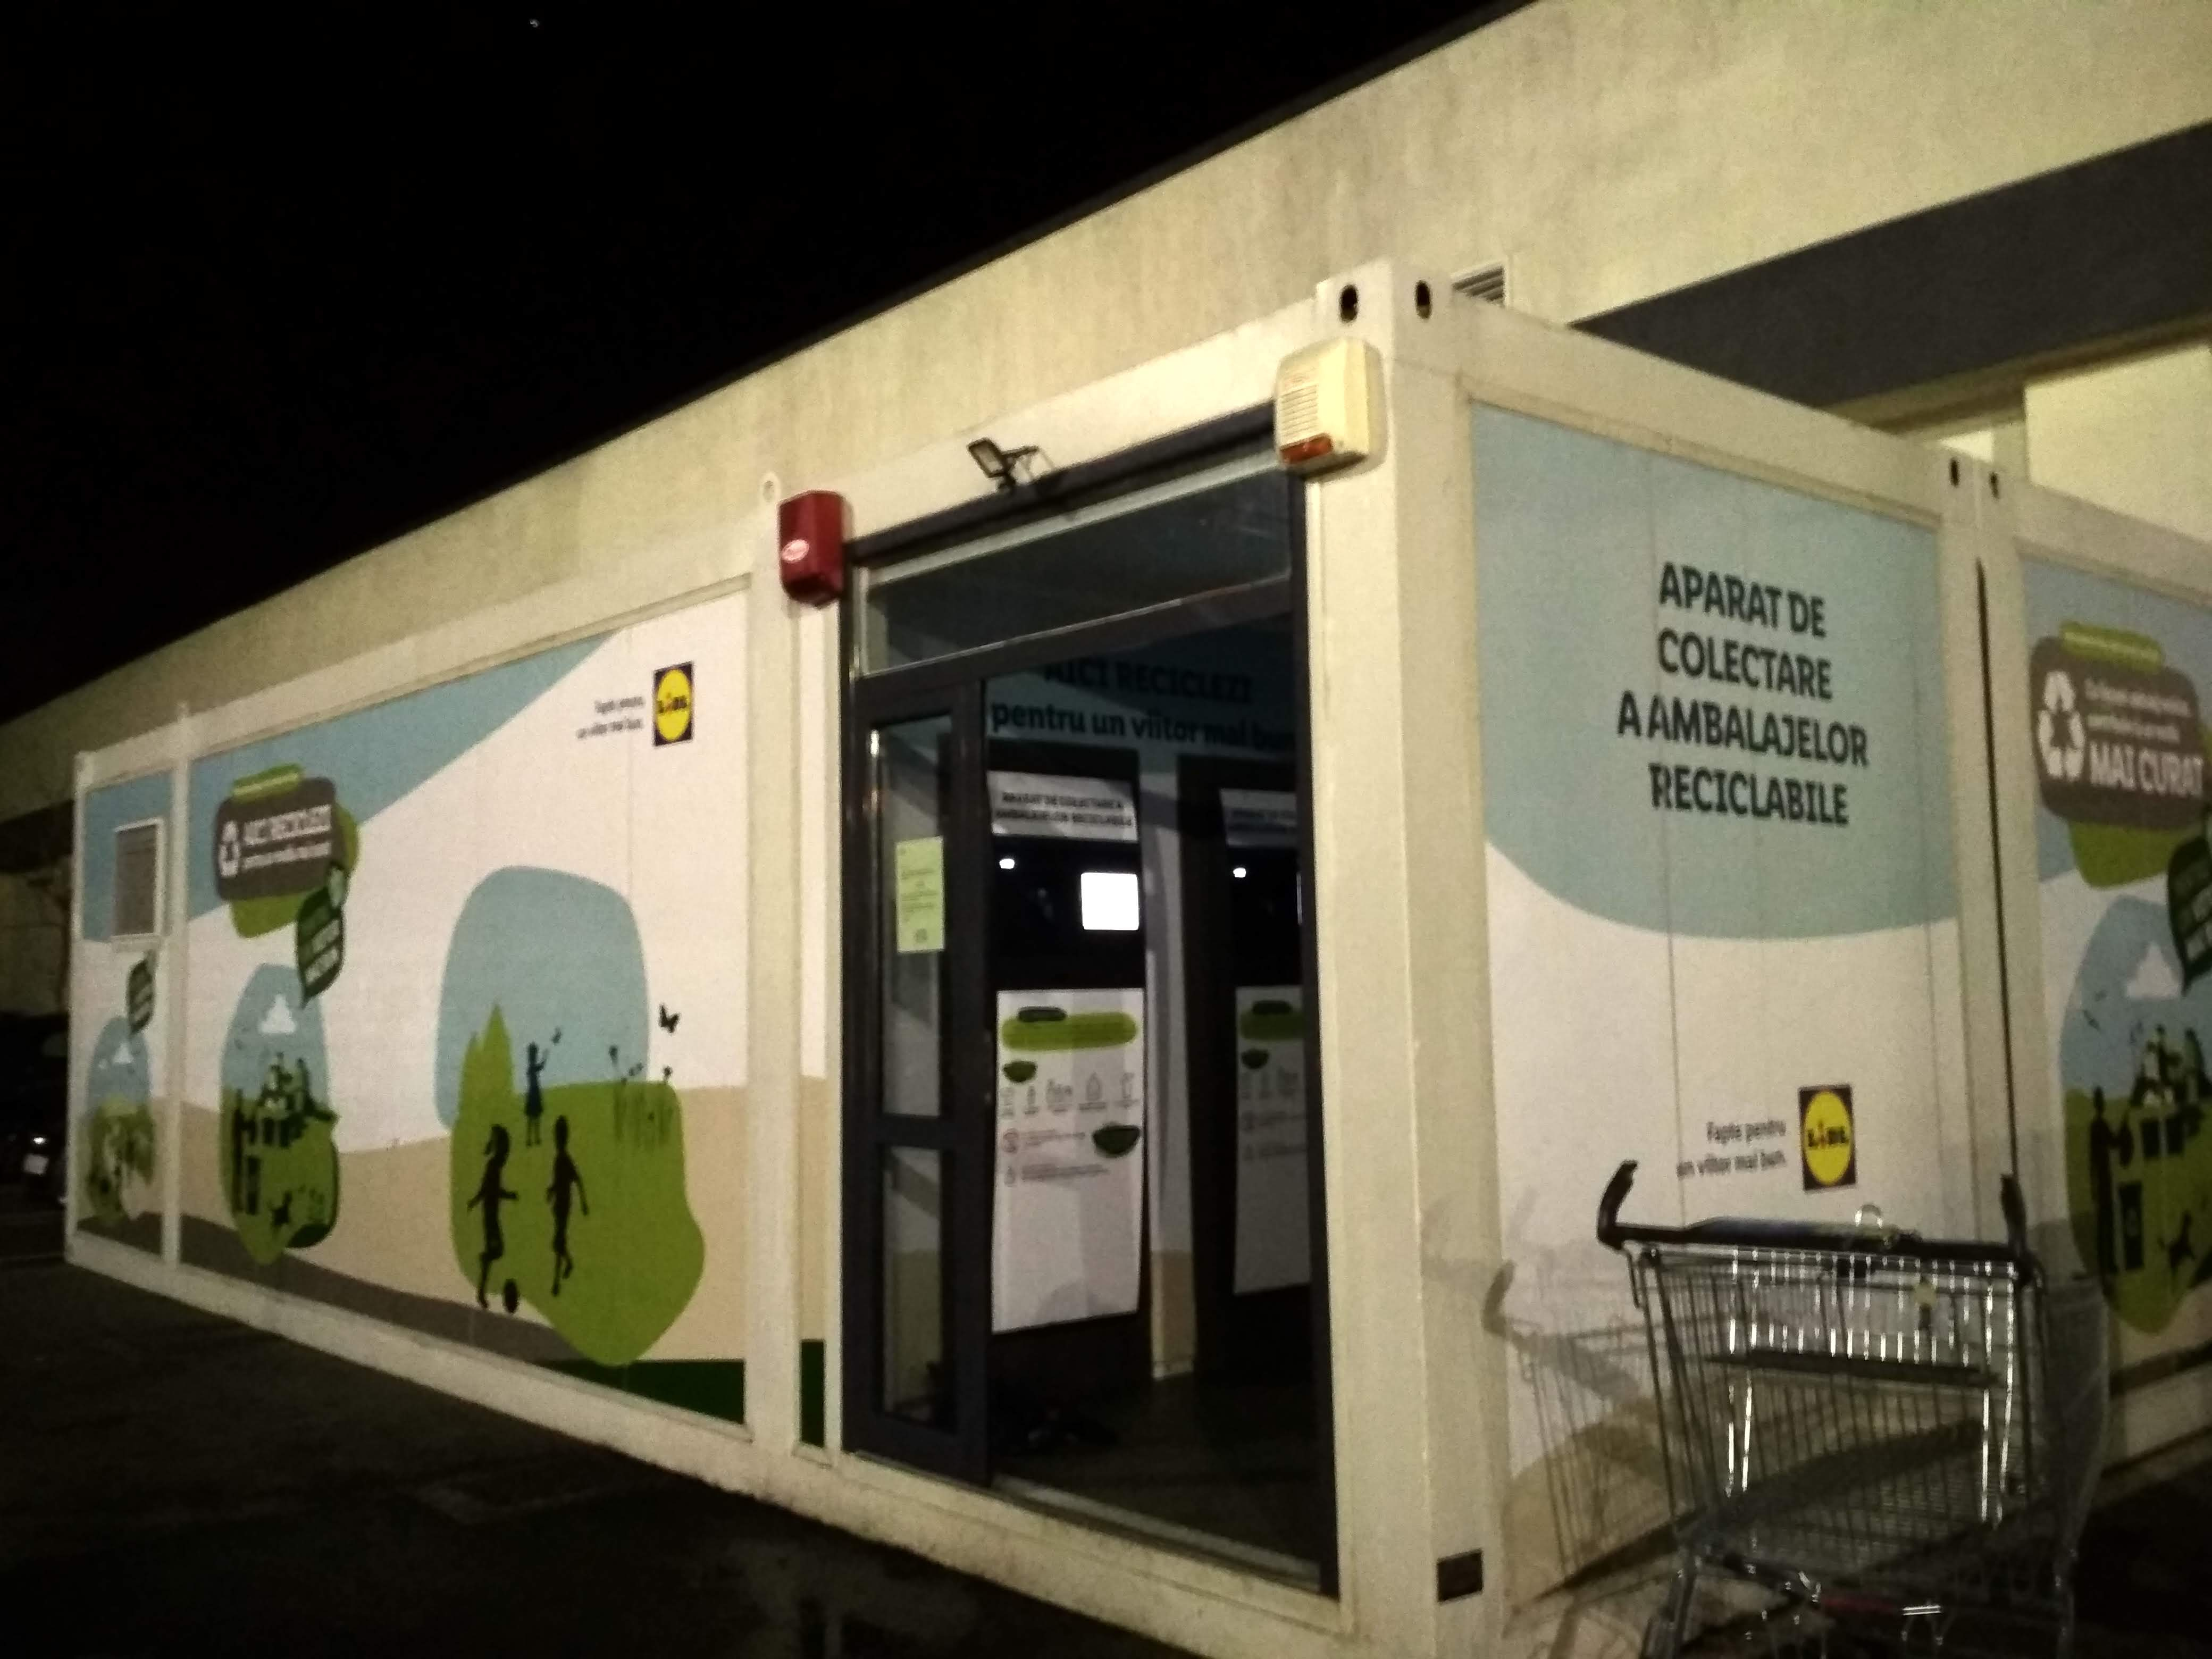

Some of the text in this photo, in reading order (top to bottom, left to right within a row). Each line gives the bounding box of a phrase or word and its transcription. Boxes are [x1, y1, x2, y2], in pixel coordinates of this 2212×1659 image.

[1658, 562, 1827, 638] APARAT DE
[1657, 627, 1833, 701] COLECTARE
[992, 701, 1084, 733] pentru
[1092, 714, 1125, 736] un
[1132, 708, 1197, 742] viitor
[1617, 689, 1869, 766] A AMBALAJELOR
[1649, 761, 1849, 826] RECICLABILE
